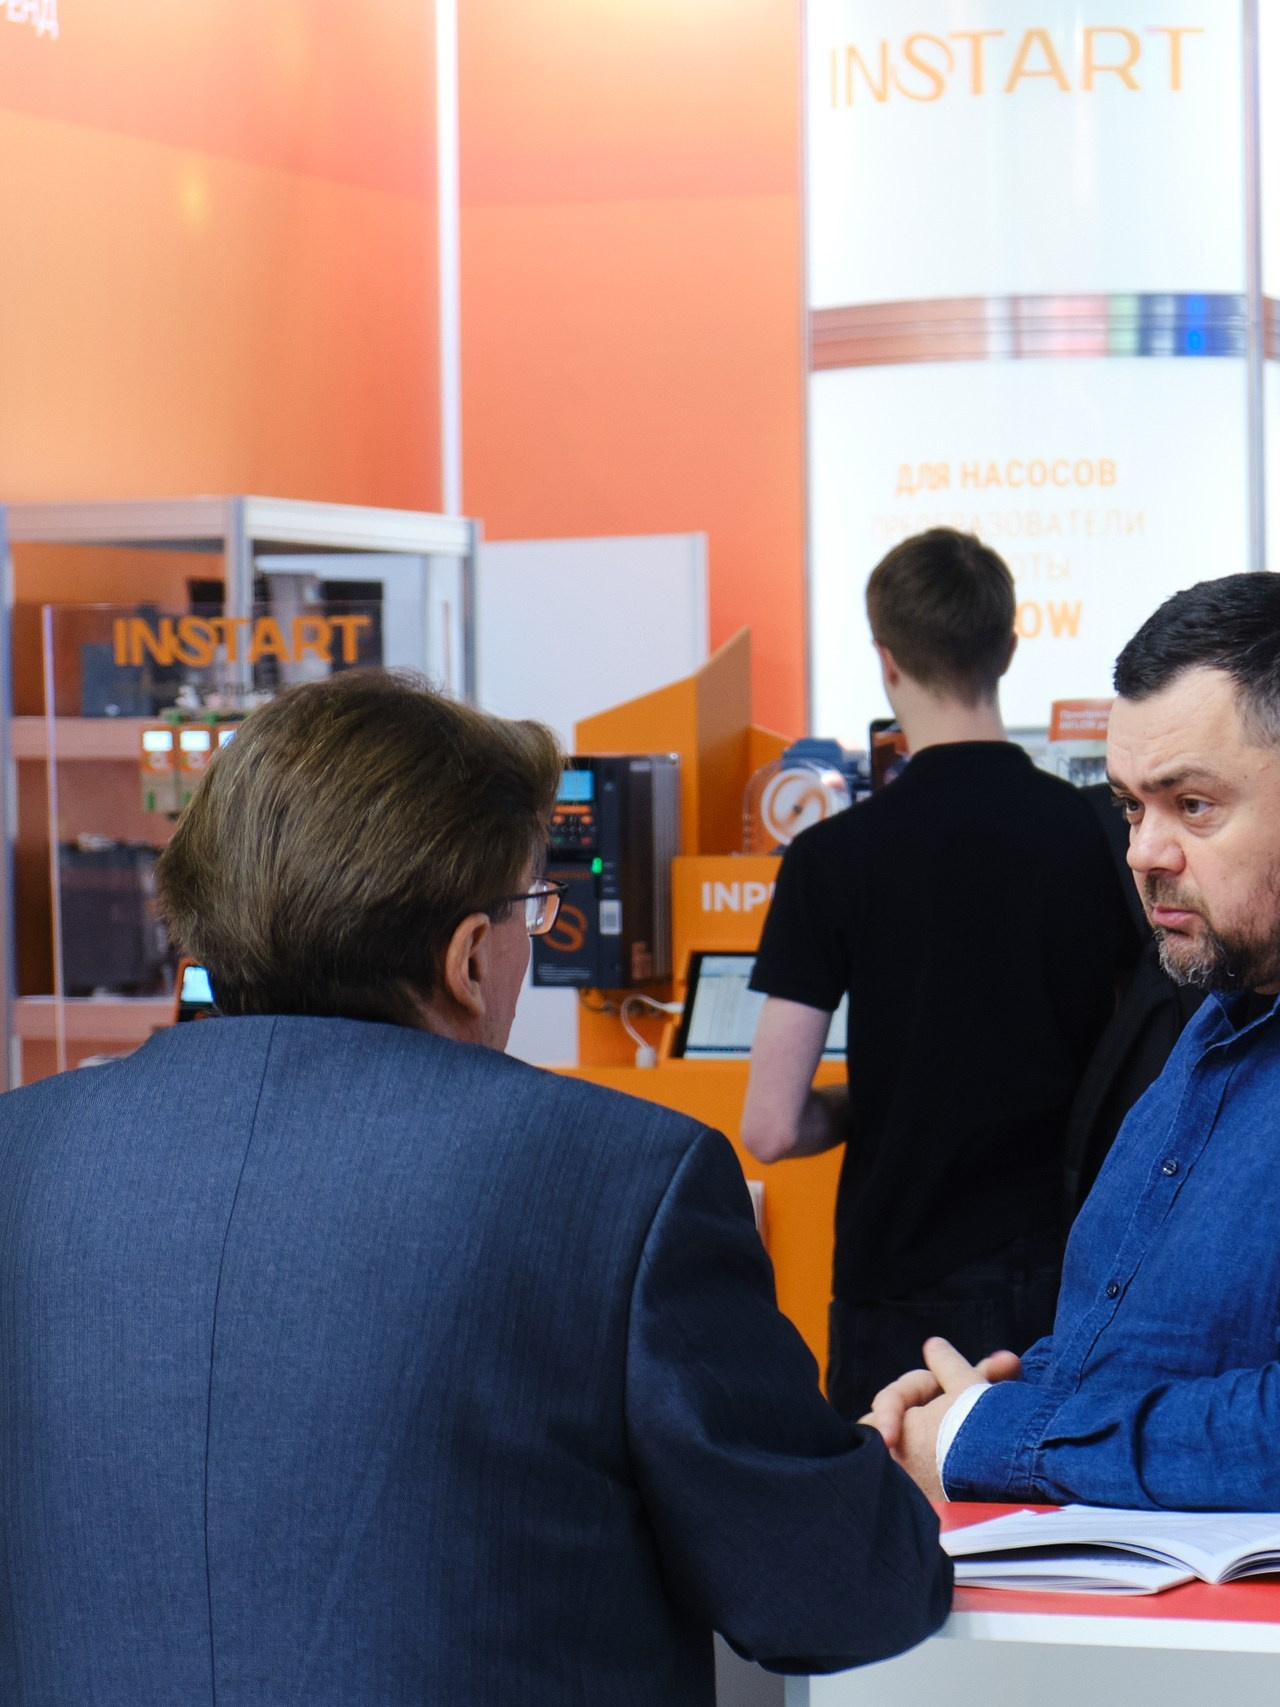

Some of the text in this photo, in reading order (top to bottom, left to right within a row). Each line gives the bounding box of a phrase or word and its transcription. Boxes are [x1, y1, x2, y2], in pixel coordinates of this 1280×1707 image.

[830, 25, 1205, 109] INSTART
[896, 458, 1118, 497] ДЛЯ НАСОСОВ
[1011, 552, 1073, 582] ОТЫ
[1014, 599, 1083, 640] OW
[113, 613, 372, 668] INSTART
[702, 881, 776, 912] INP
